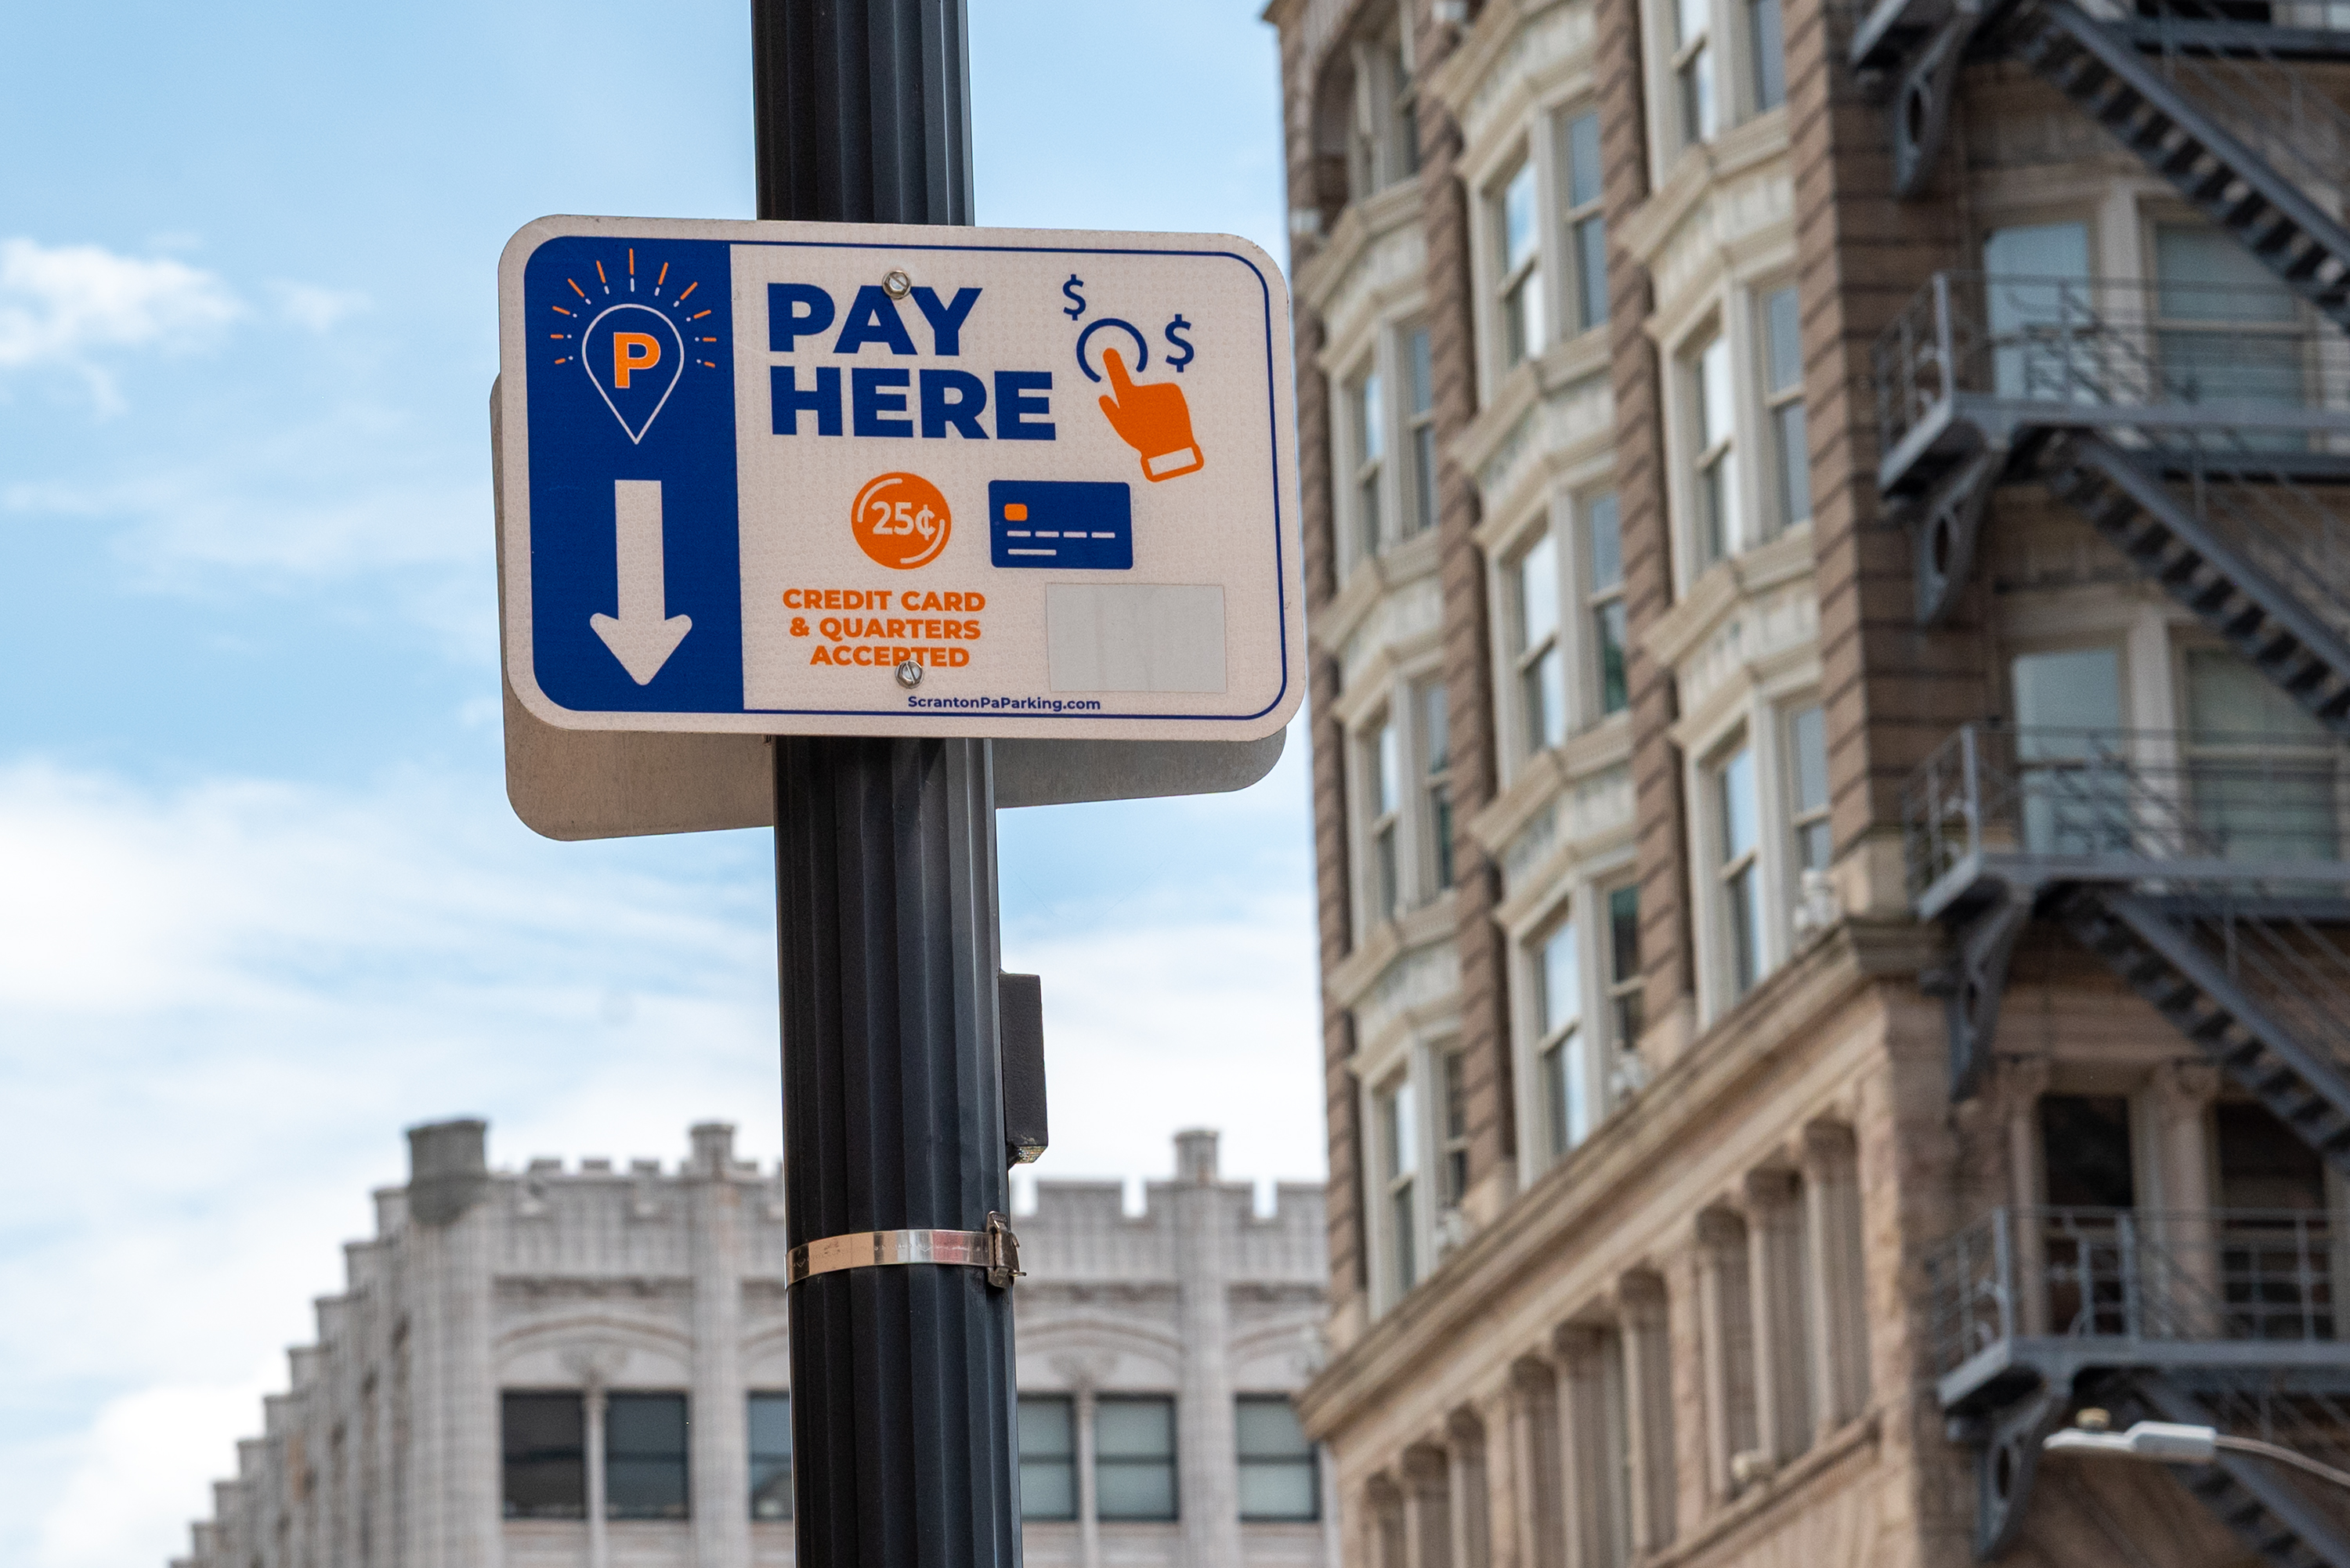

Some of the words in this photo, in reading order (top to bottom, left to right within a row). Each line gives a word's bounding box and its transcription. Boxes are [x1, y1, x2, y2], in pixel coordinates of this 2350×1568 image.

[1062, 274, 1086, 321] $
[767, 283, 982, 356] PAY
[613, 332, 660, 388] P
[1165, 313, 1195, 373] $
[770, 365, 1057, 441] HERE
[870, 500, 936, 540] 25¢
[783, 588, 893, 611] CREDIT
[900, 591, 986, 612] CARD
[789, 616, 811, 638] &
[819, 617, 982, 642] QUARTERS
[809, 645, 971, 668] ACCEPTED
[907, 695, 1101, 712] ScrantonPaParking.com
